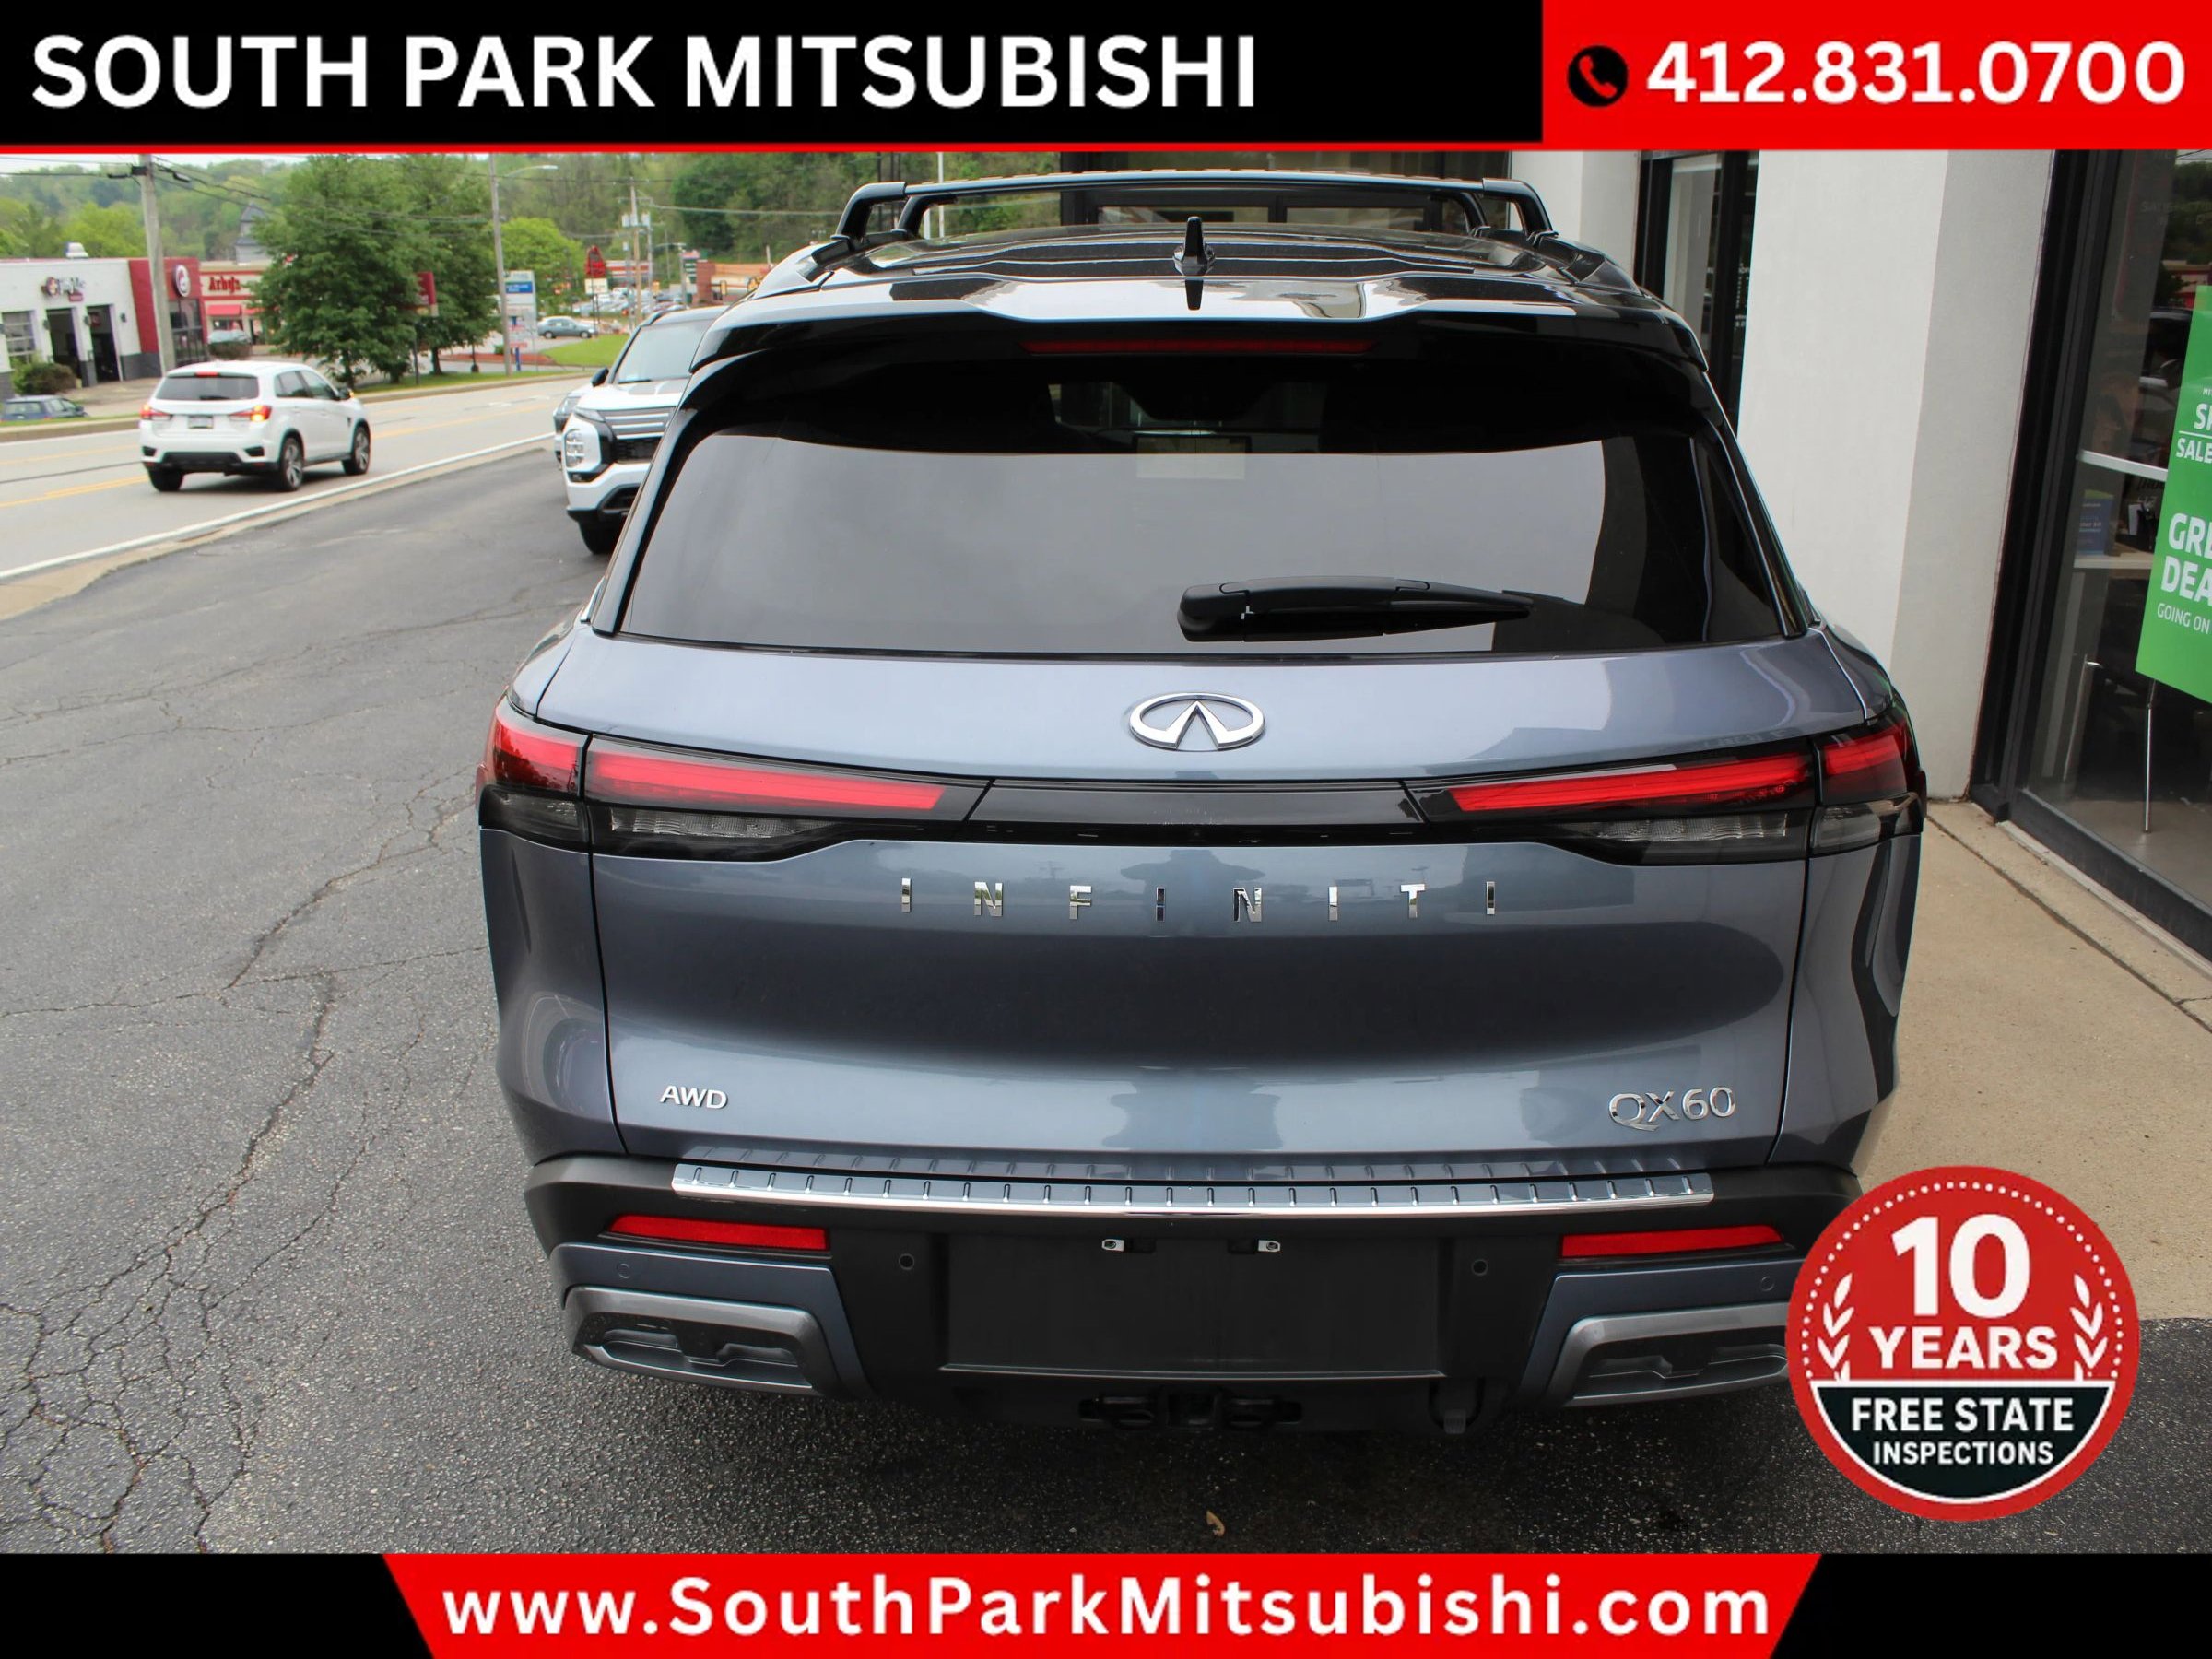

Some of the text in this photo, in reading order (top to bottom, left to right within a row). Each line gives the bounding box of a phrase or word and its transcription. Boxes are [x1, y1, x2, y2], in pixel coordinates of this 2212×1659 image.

[2157, 603, 2210, 635] GOING ON
[900, 877, 1496, 922] INFINITI
[660, 1085, 728, 1109] AWD
[1608, 1086, 1735, 1132] QX60
